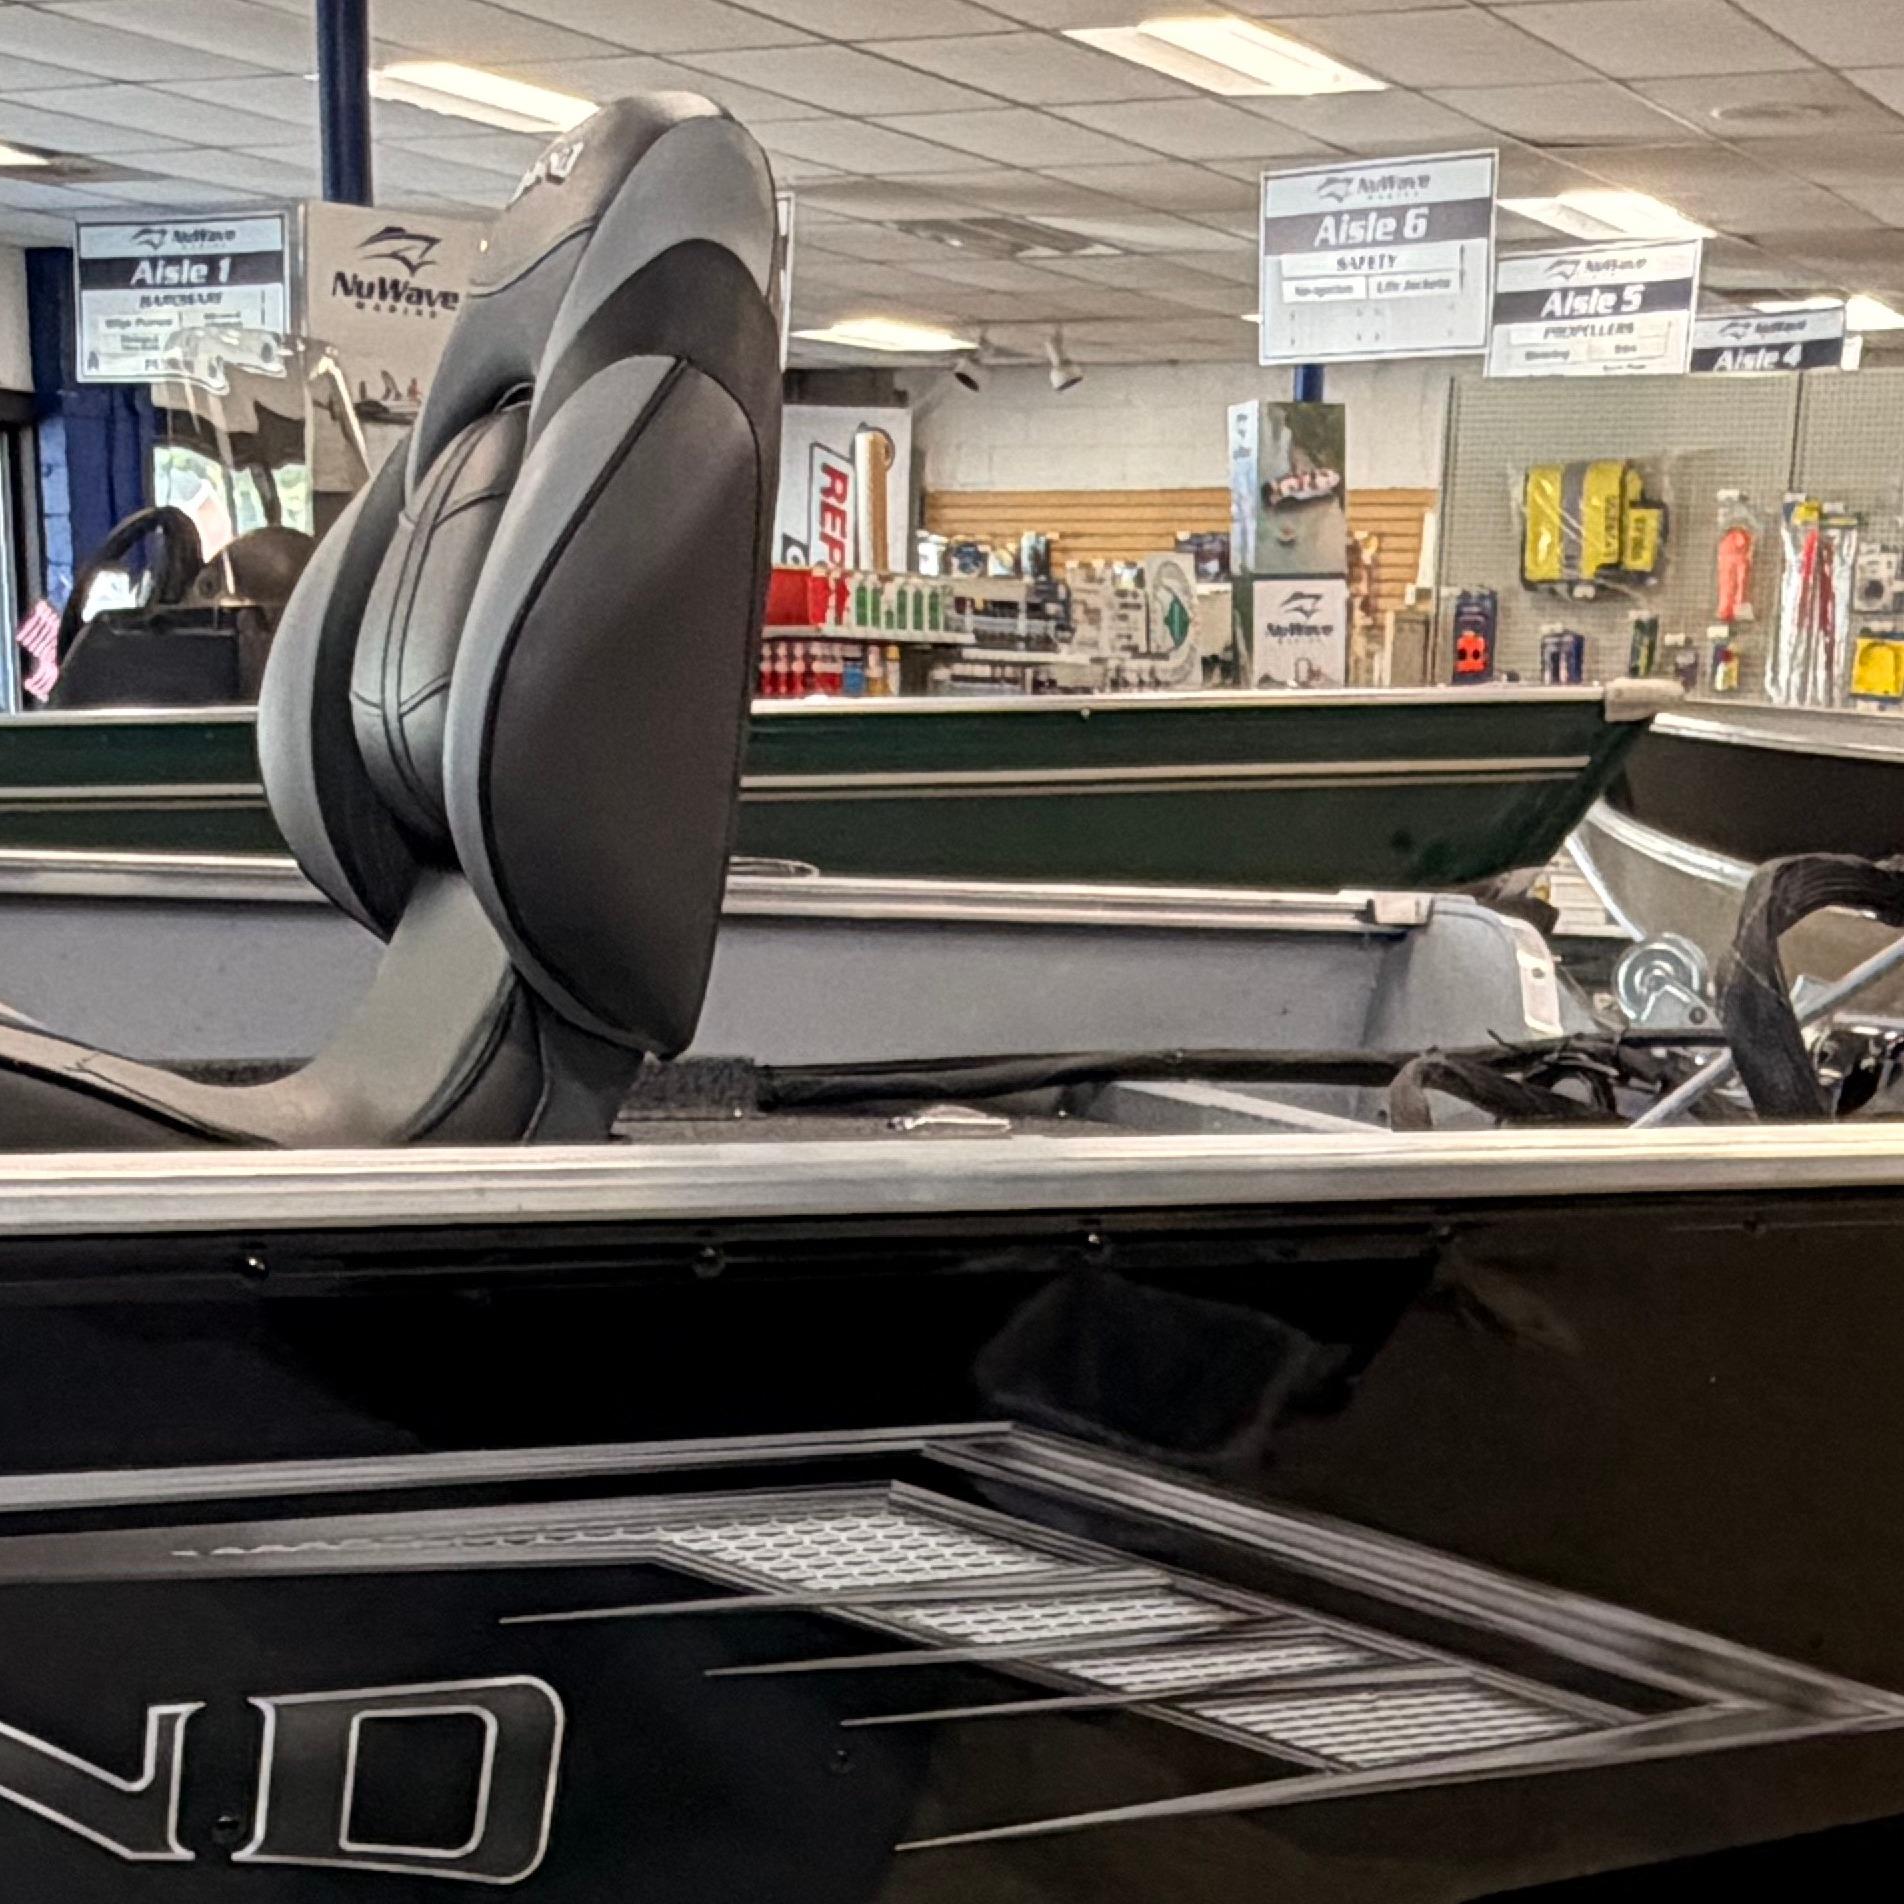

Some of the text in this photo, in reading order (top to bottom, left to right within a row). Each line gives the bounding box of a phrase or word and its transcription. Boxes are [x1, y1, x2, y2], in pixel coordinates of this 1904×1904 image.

[1312, 206, 1430, 248] Aisle 6
[130, 256, 232, 287] Aisle 1
[1336, 254, 1398, 271] SAFETY
[331, 270, 460, 311] NuWave
[1540, 284, 1646, 319] Aisle 5
